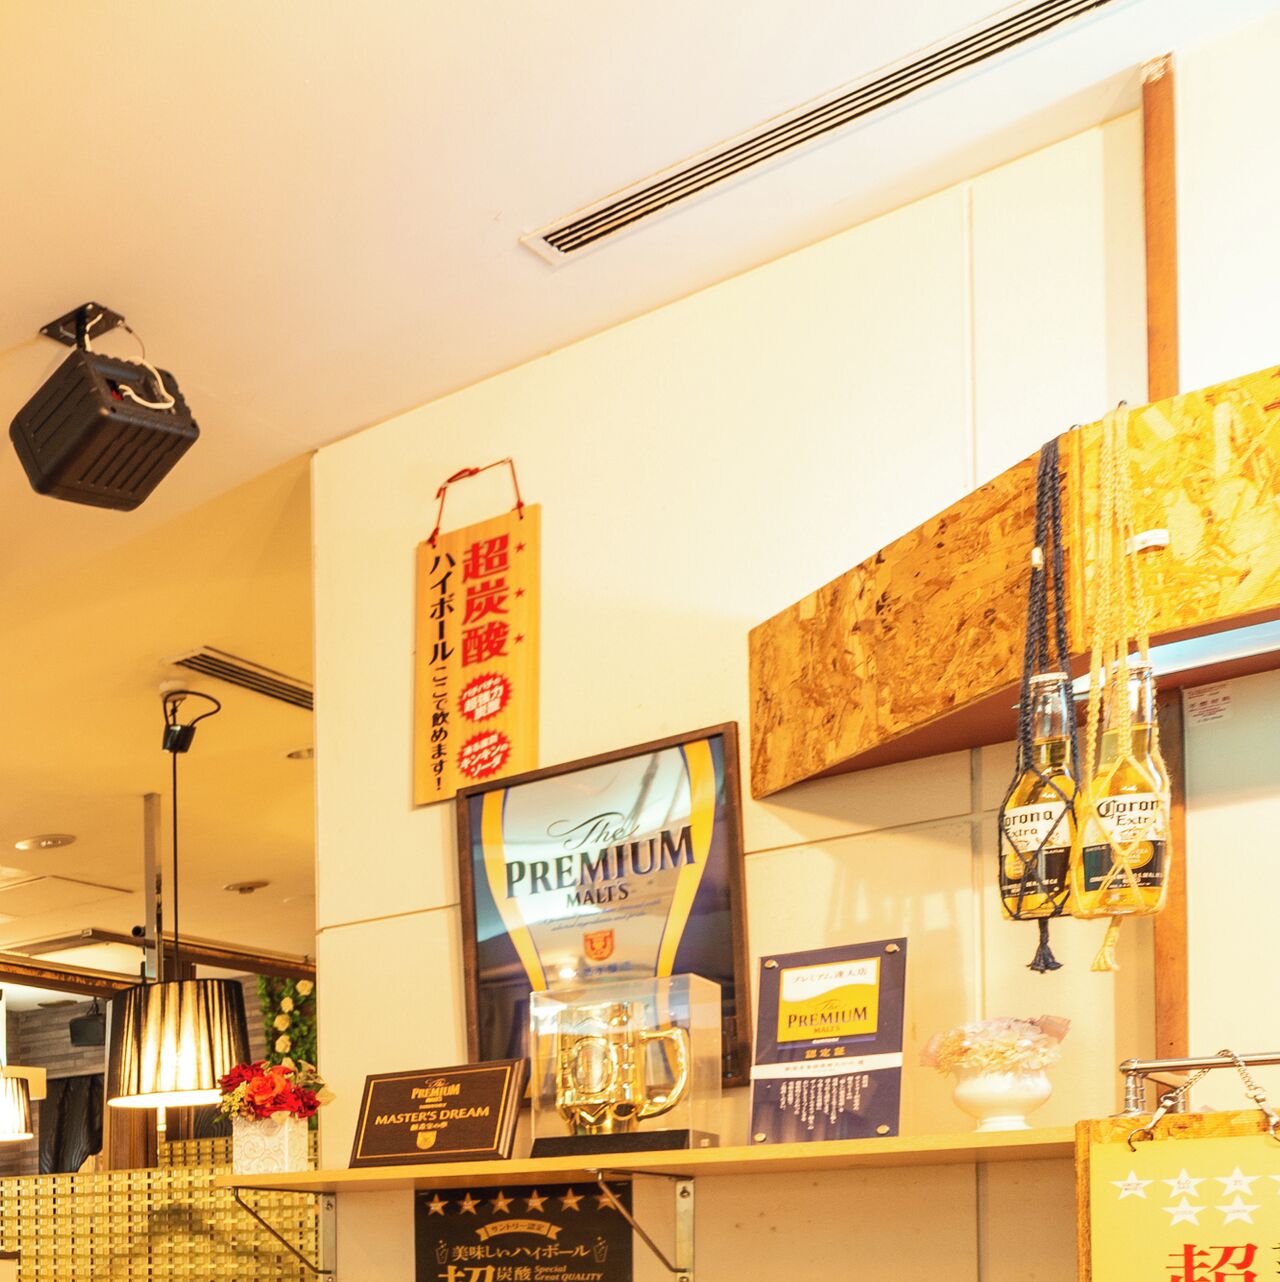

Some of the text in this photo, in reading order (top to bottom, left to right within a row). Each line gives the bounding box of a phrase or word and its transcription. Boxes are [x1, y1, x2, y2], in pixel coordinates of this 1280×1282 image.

[461, 533, 510, 668] 超炭酸
[1004, 810, 1054, 827] orona
[505, 825, 696, 898] PREMIUM
[787, 1006, 868, 1029] PREMIUM
[411, 1083, 461, 1100] PREMIUM
[375, 1106, 490, 1126] MASTER'S DREAM
[452, 1243, 591, 1261] 美味しいハイボール
